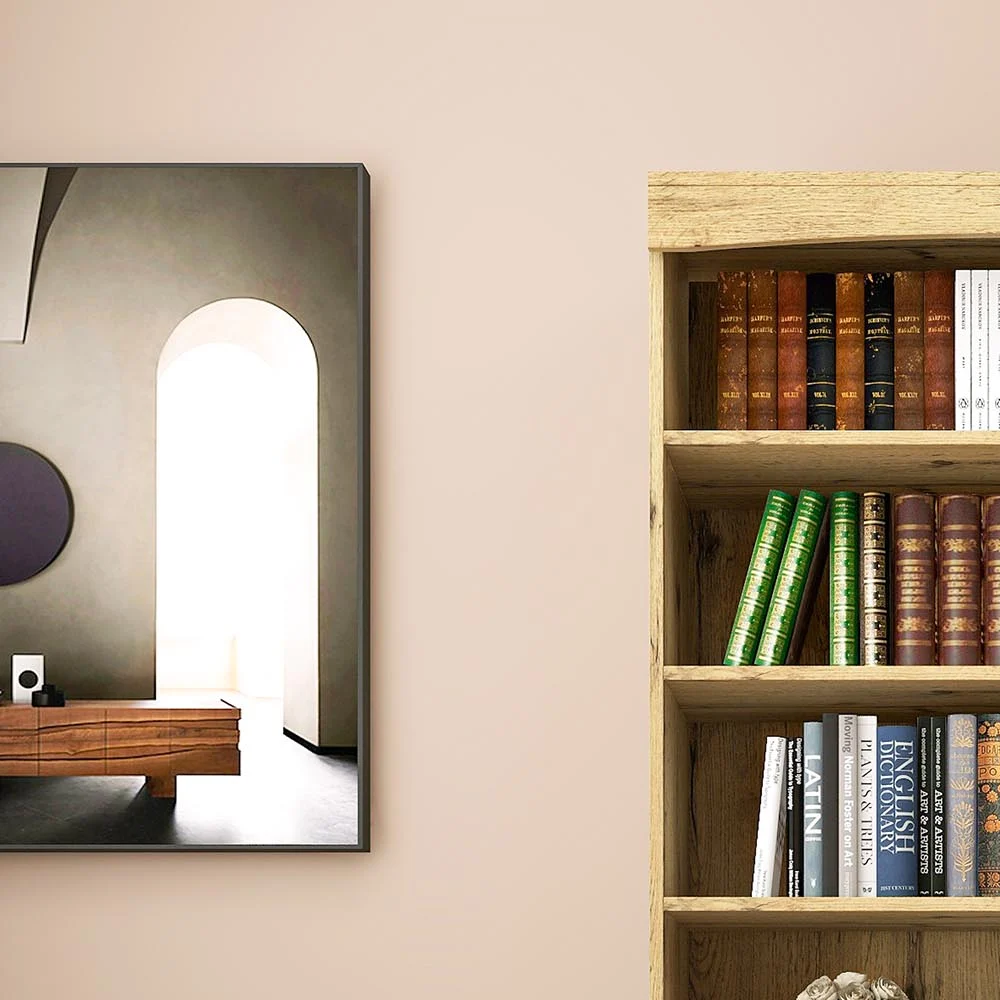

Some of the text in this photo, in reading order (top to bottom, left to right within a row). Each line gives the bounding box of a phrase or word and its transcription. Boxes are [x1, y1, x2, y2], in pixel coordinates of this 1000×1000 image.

[934, 738, 942, 764] complete
[934, 765, 942, 782] guide
[804, 754, 822, 834] LATIN
[842, 716, 854, 867] Moving Norman Foster on Art
[860, 739, 873, 866] PLANTS & TREES
[879, 740, 894, 854] DICTIONARY
[894, 740, 915, 854] ENGLISH
[934, 789, 943, 813] ART
[934, 826, 943, 875] ARTISTS
